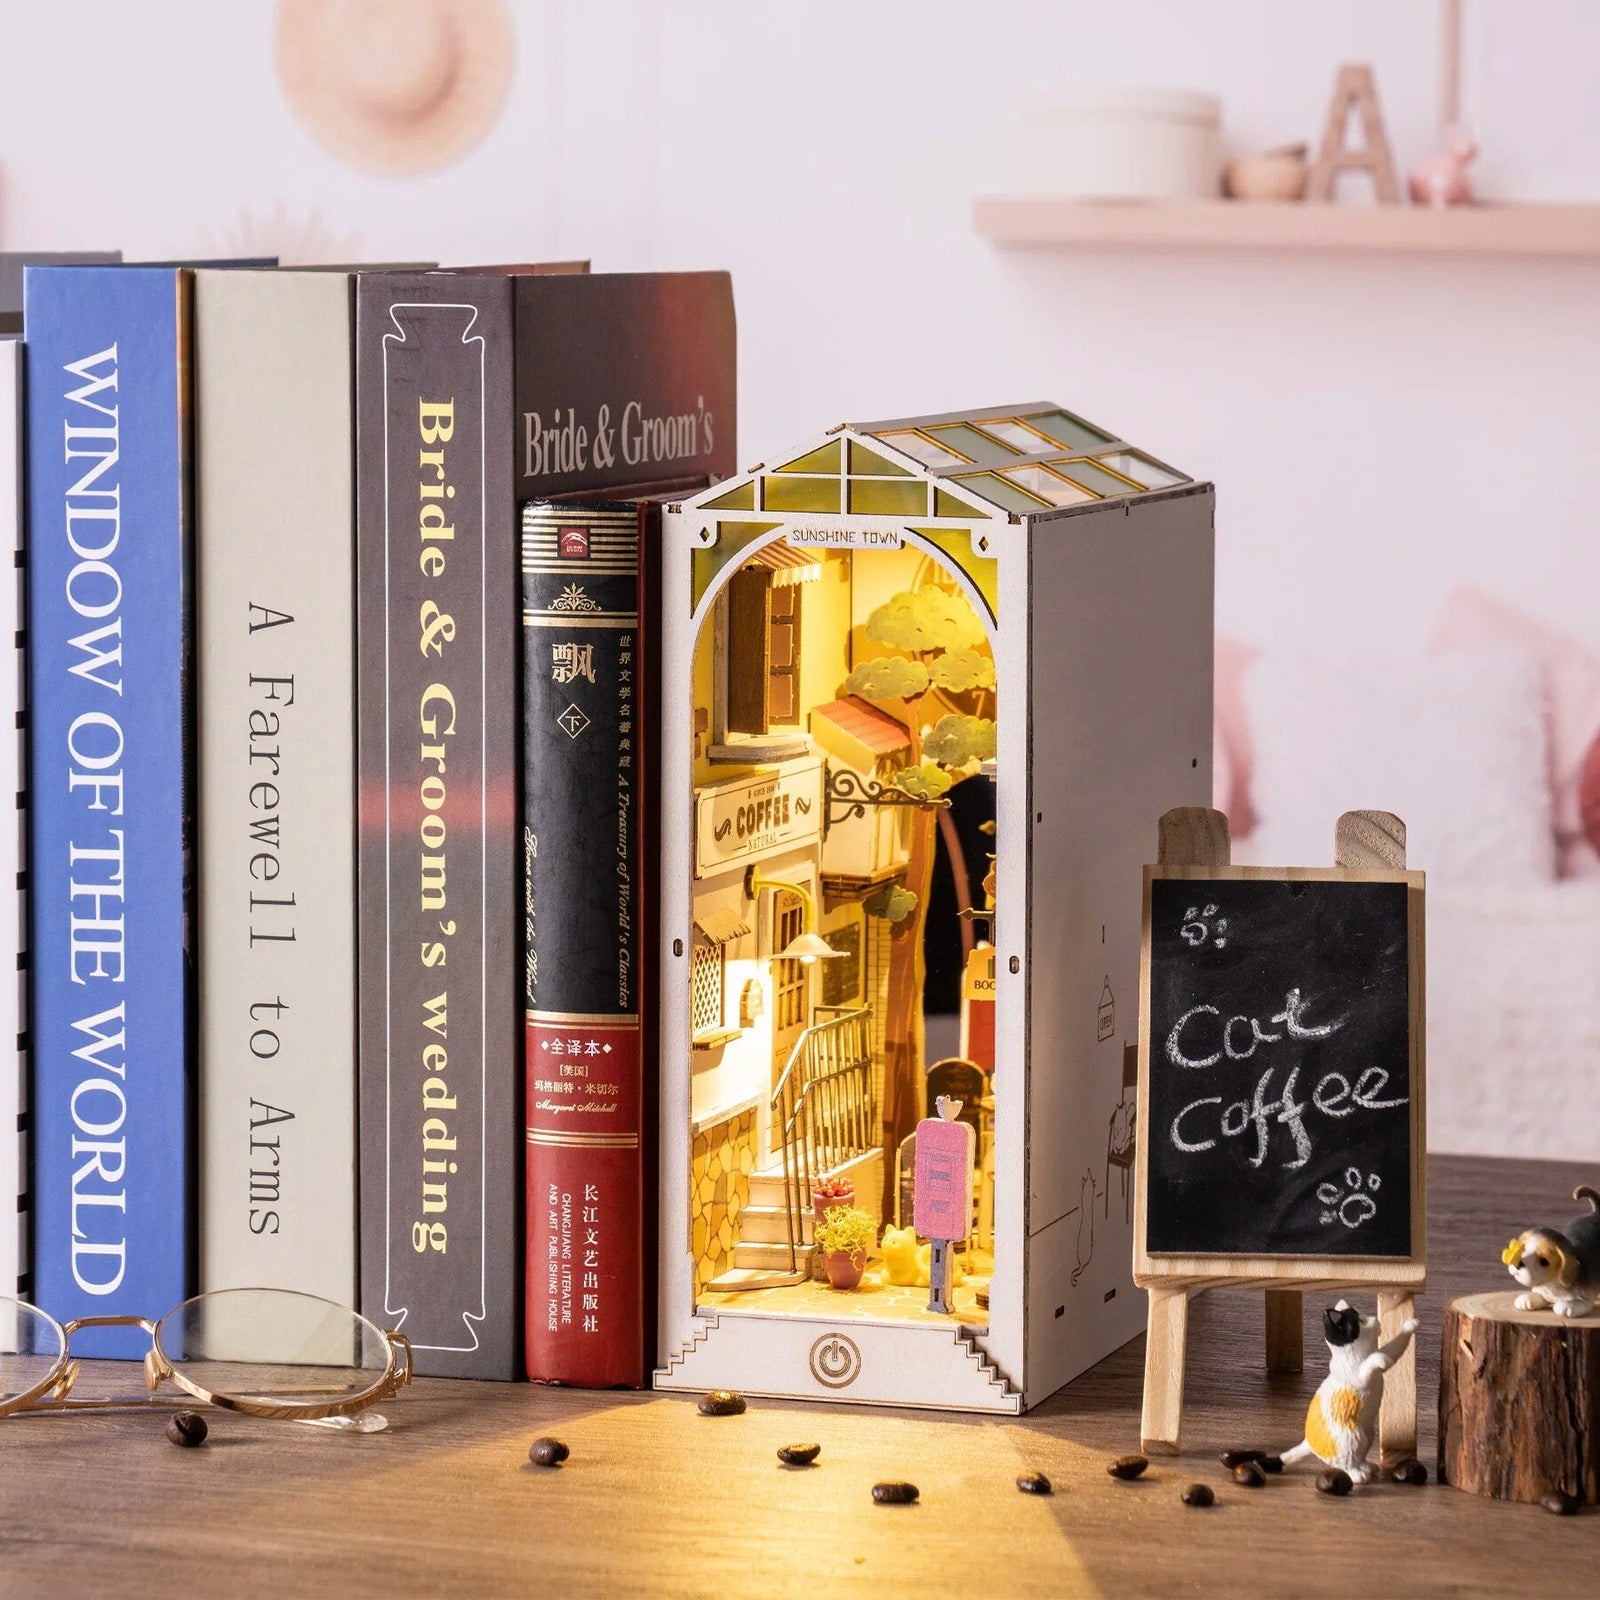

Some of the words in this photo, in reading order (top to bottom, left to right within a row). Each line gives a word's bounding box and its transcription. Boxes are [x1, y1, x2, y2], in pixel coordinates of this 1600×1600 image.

[523, 408, 588, 477] Bride
[593, 403, 615, 469] &
[621, 395, 714, 465] Groom's
[419, 396, 456, 578] Bride
[62, 341, 123, 697] WINDOW
[793, 528, 856, 543] SUNSHINE
[863, 532, 898, 544] TOWN
[249, 601, 295, 635] A
[420, 599, 456, 658] &
[551, 643, 596, 684] 飘
[565, 715, 582, 732] 下
[618, 635, 632, 768] 世界文学名著典藏
[68, 711, 124, 816] OF
[618, 773, 630, 787] A
[248, 672, 297, 949] Farewell
[419, 682, 457, 968] Groom's
[617, 792, 630, 859] Treasury
[737, 794, 789, 838] COFFEE
[617, 862, 630, 881] of
[748, 832, 777, 851] NATURAL
[70, 829, 125, 986] THE
[526, 878, 536, 917] with
[526, 917, 536, 941] the
[526, 949, 538, 1004] Wind
[619, 948, 631, 1009] Classics
[249, 994, 290, 1059] to
[550, 1038, 601, 1057] 全译本
[1165, 987, 1352, 1069] Cat
[413, 991, 458, 1255] wedding
[535, 1099, 577, 1115] Margaret
[576, 1101, 618, 1113] Mitchell
[71, 999, 127, 1296] WORLD
[249, 1097, 296, 1236] Arms
[548, 1183, 558, 1206] AND
[548, 1210, 558, 1231] ART
[561, 1193, 572, 1259] CHANGJIANG
[548, 1236, 558, 1294] PUBLISHING
[582, 1184, 599, 1333] 长江文艺出版社
[548, 1299, 558, 1332] HOUSE
[561, 1264, 572, 1325] LITERATURE
